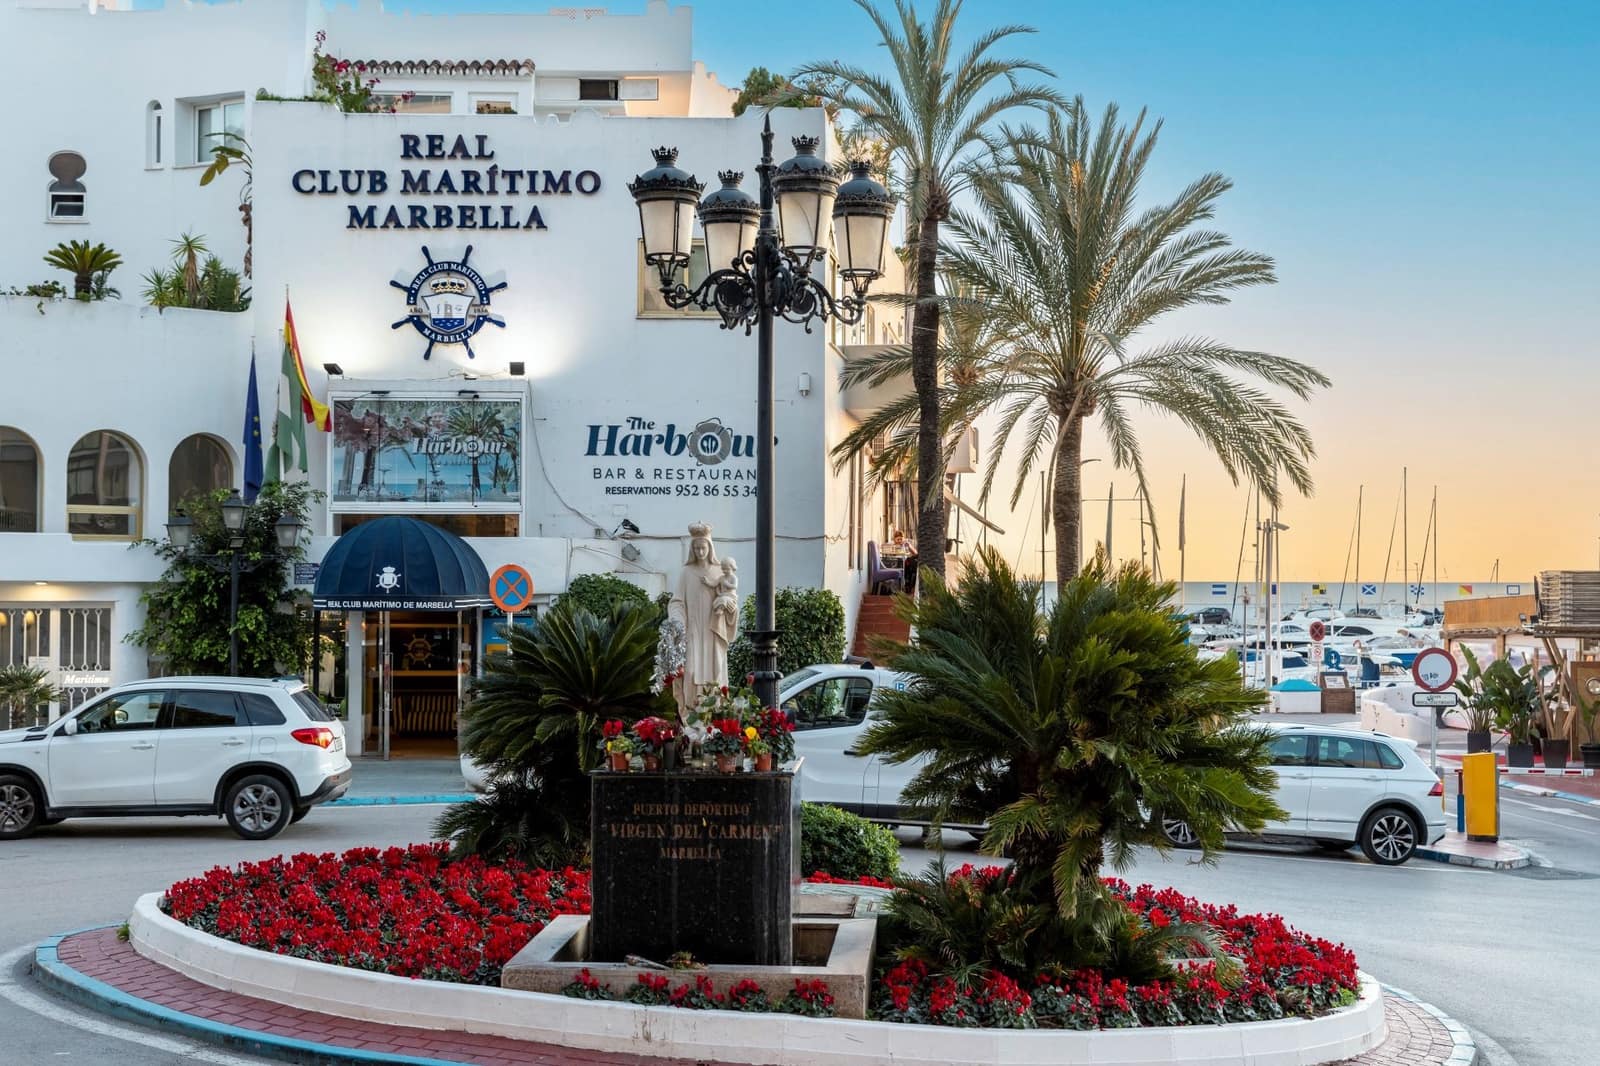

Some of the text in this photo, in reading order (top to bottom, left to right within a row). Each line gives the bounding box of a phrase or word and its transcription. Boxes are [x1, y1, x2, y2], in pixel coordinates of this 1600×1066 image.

[400, 134, 495, 160] REAL
[292, 163, 602, 195] CLUB MARÍTIMO
[346, 204, 548, 230] MARBELLA
[412, 270, 429, 290] REAL
[427, 262, 449, 274] CLUB
[422, 327, 474, 342] MARBELLA
[626, 416, 655, 431] The
[584, 421, 778, 464] Harbou
[593, 468, 757, 481] BAR & RESTAURAN
[605, 486, 672, 496] RESERVATIONS
[675, 484, 700, 497] 952
[703, 484, 720, 497] 86
[723, 485, 740, 498] 55
[327, 600, 342, 609] REAL
[343, 600, 361, 609] CLUB
[403, 601, 415, 609] DE
[416, 601, 454, 609] MARBELLA
[633, 802, 750, 816] PUERTO DEPORTIVO
[611, 823, 666, 839] VIRGEN
[672, 824, 703, 840] DEL
